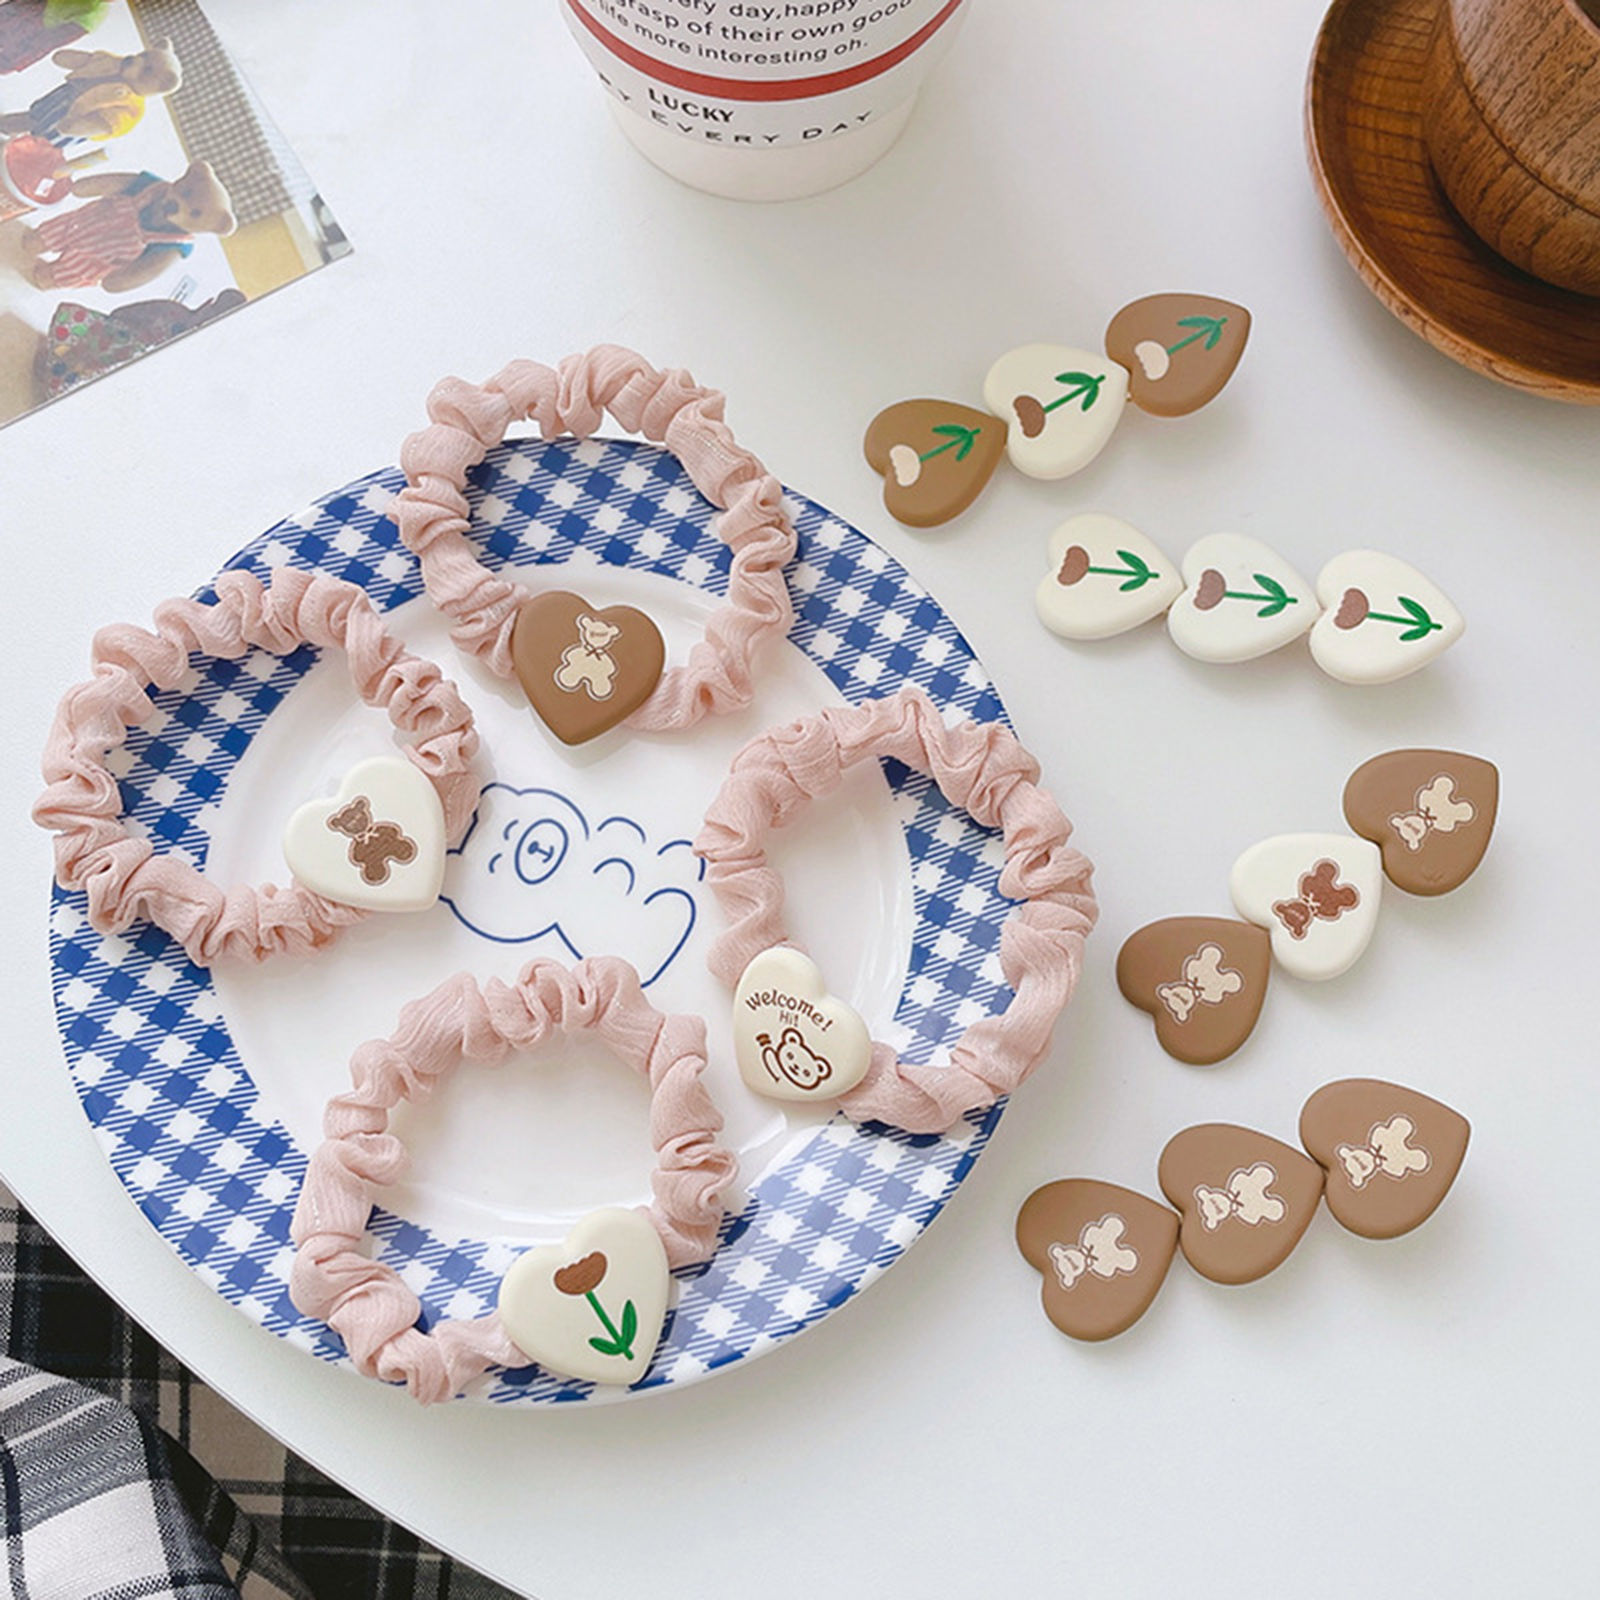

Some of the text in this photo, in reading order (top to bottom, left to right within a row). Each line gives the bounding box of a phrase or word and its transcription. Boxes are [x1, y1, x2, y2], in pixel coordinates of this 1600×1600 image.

[634, 23, 691, 54] more
[698, 44, 827, 64] interesting
[687, 21, 713, 36] of
[721, 26, 784, 42] their
[791, 22, 844, 40] own
[648, 87, 734, 122] LUCKY
[650, 109, 872, 144] EVERY DAY
[744, 989, 833, 1032] Welcome!
[779, 1010, 799, 1027] Hi!
